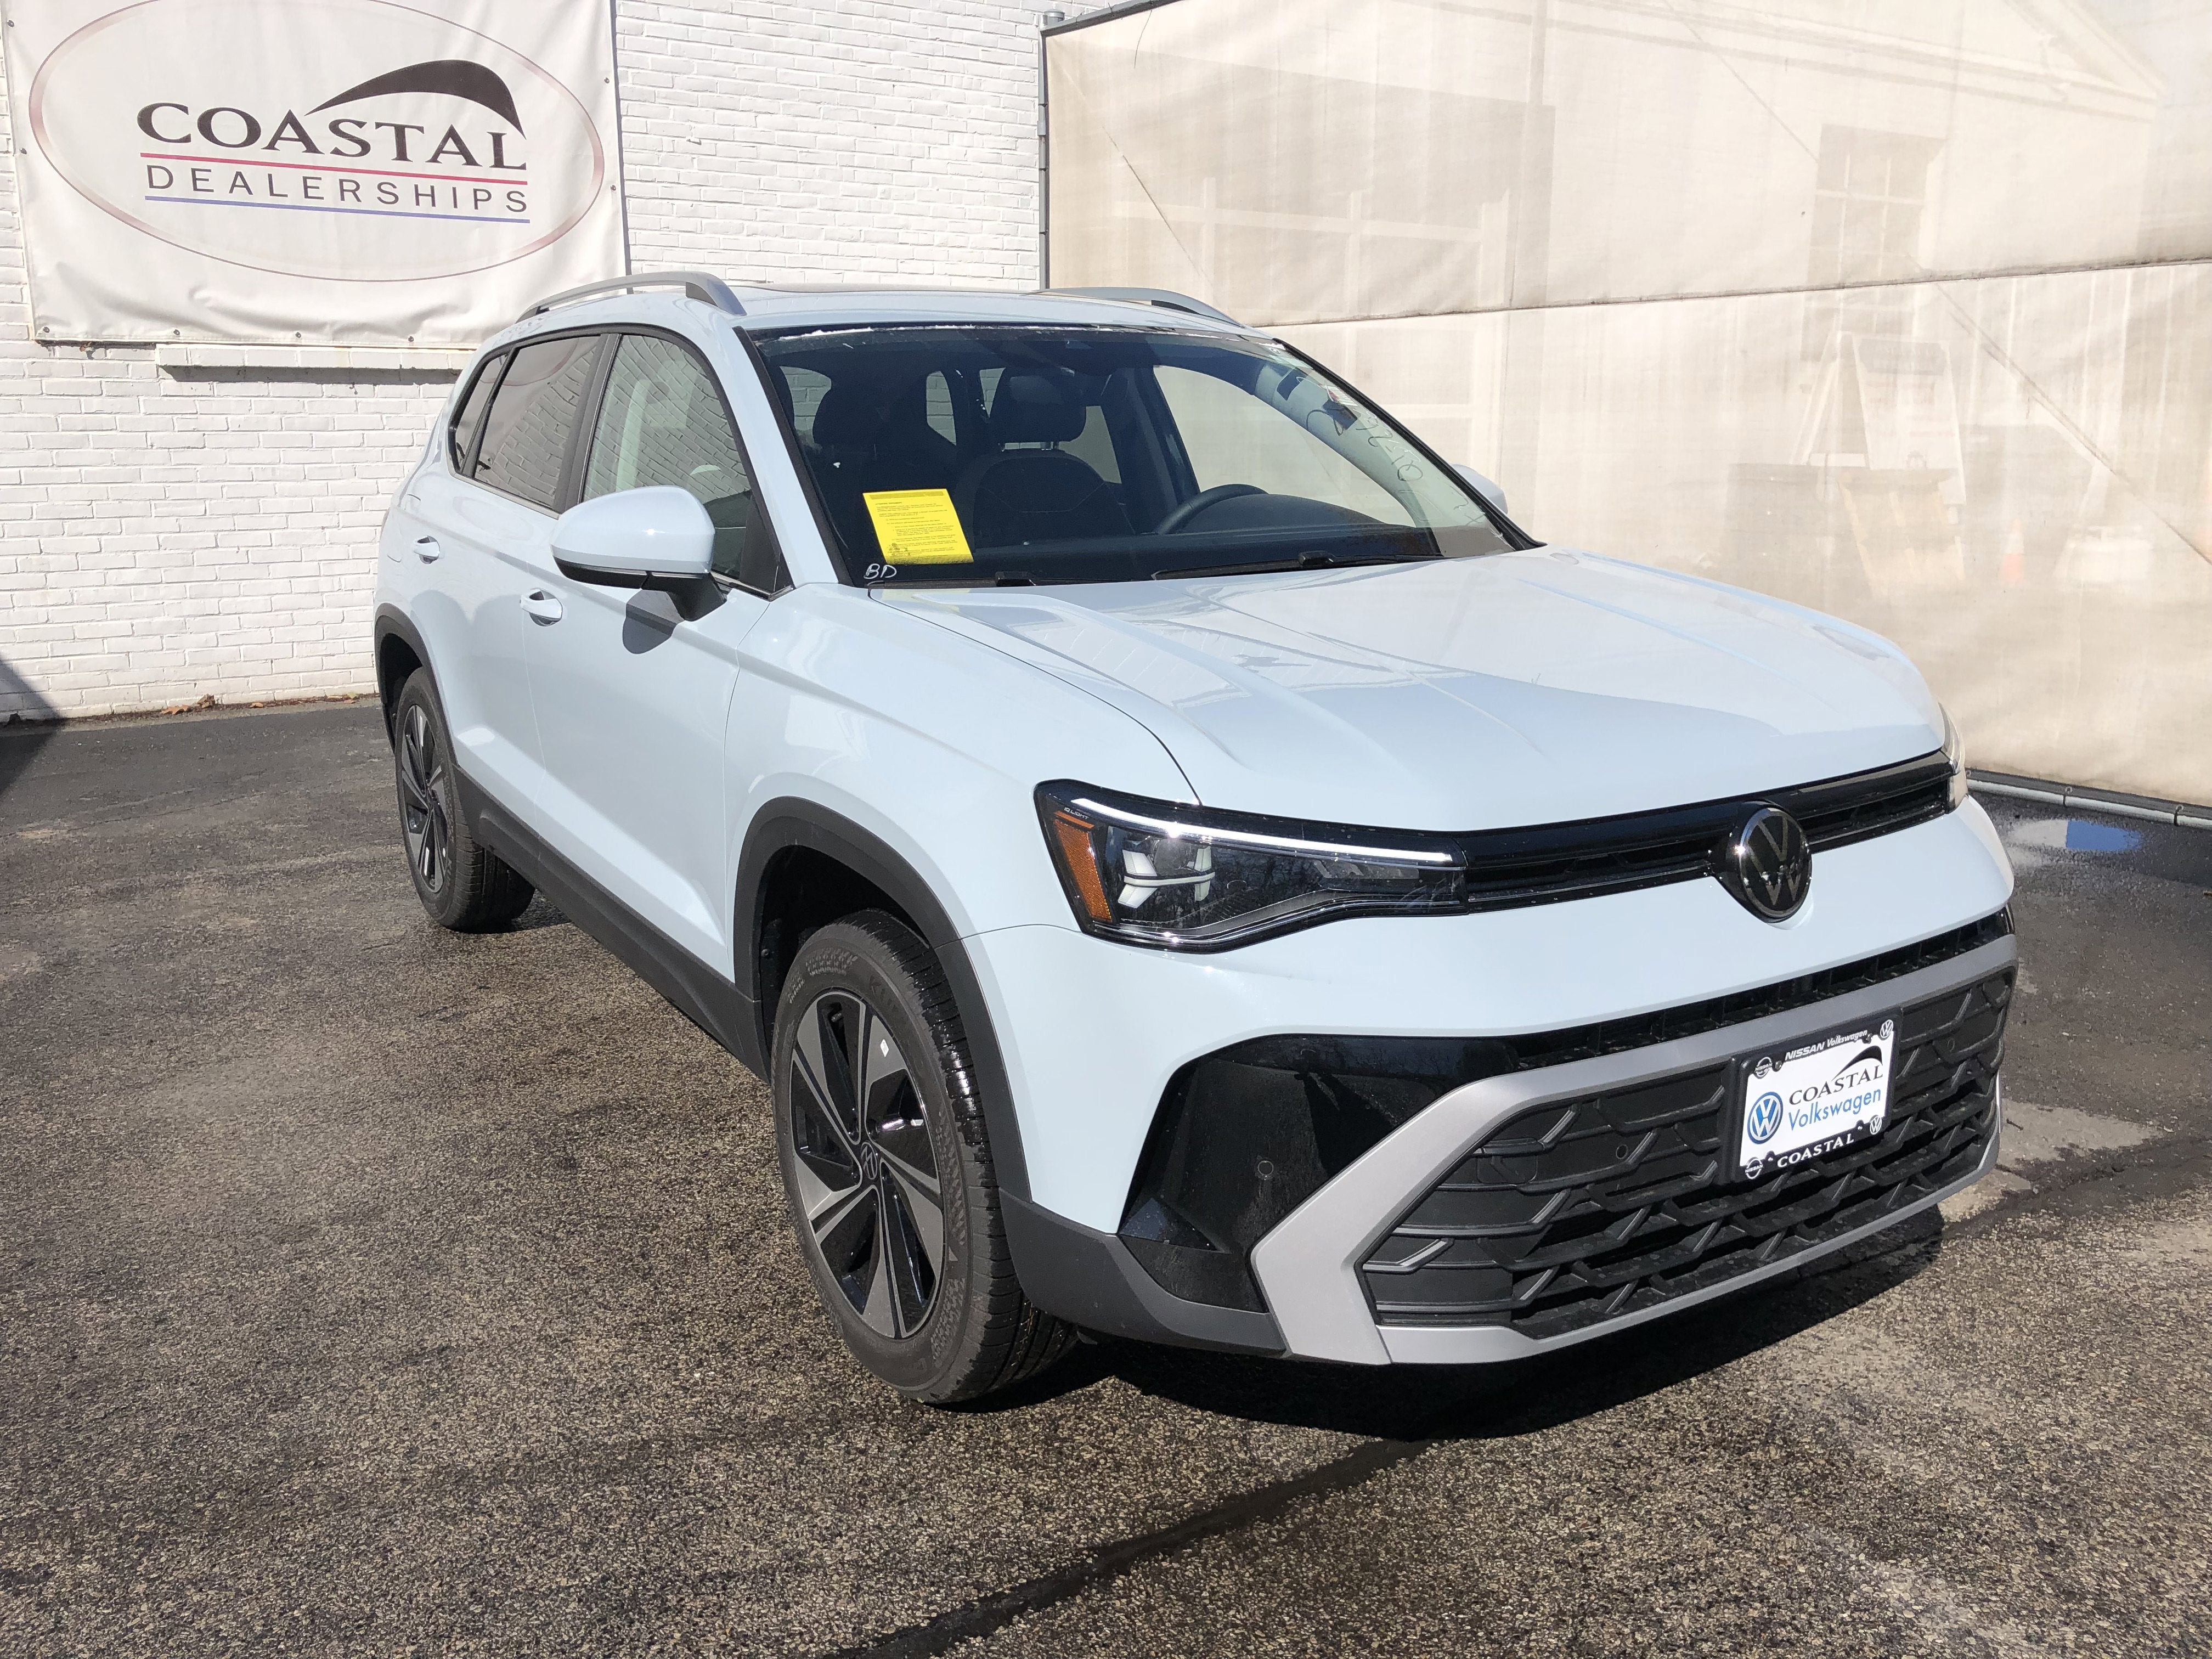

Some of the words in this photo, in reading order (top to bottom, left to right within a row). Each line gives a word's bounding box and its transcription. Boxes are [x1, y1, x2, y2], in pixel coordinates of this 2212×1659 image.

[137, 102, 527, 171] COASTAL
[147, 165, 528, 213] DEALERSHIPS
[1785, 1042, 1825, 1061] NISSAN
[1827, 1030, 1867, 1047] Volkswagen
[1789, 1065, 1883, 1105] COASTAL
[1788, 1089, 1881, 1131] Volkswagen
[1745, 1164, 1763, 1173] NISSAN
[1778, 1133, 1854, 1167] COASTAL
